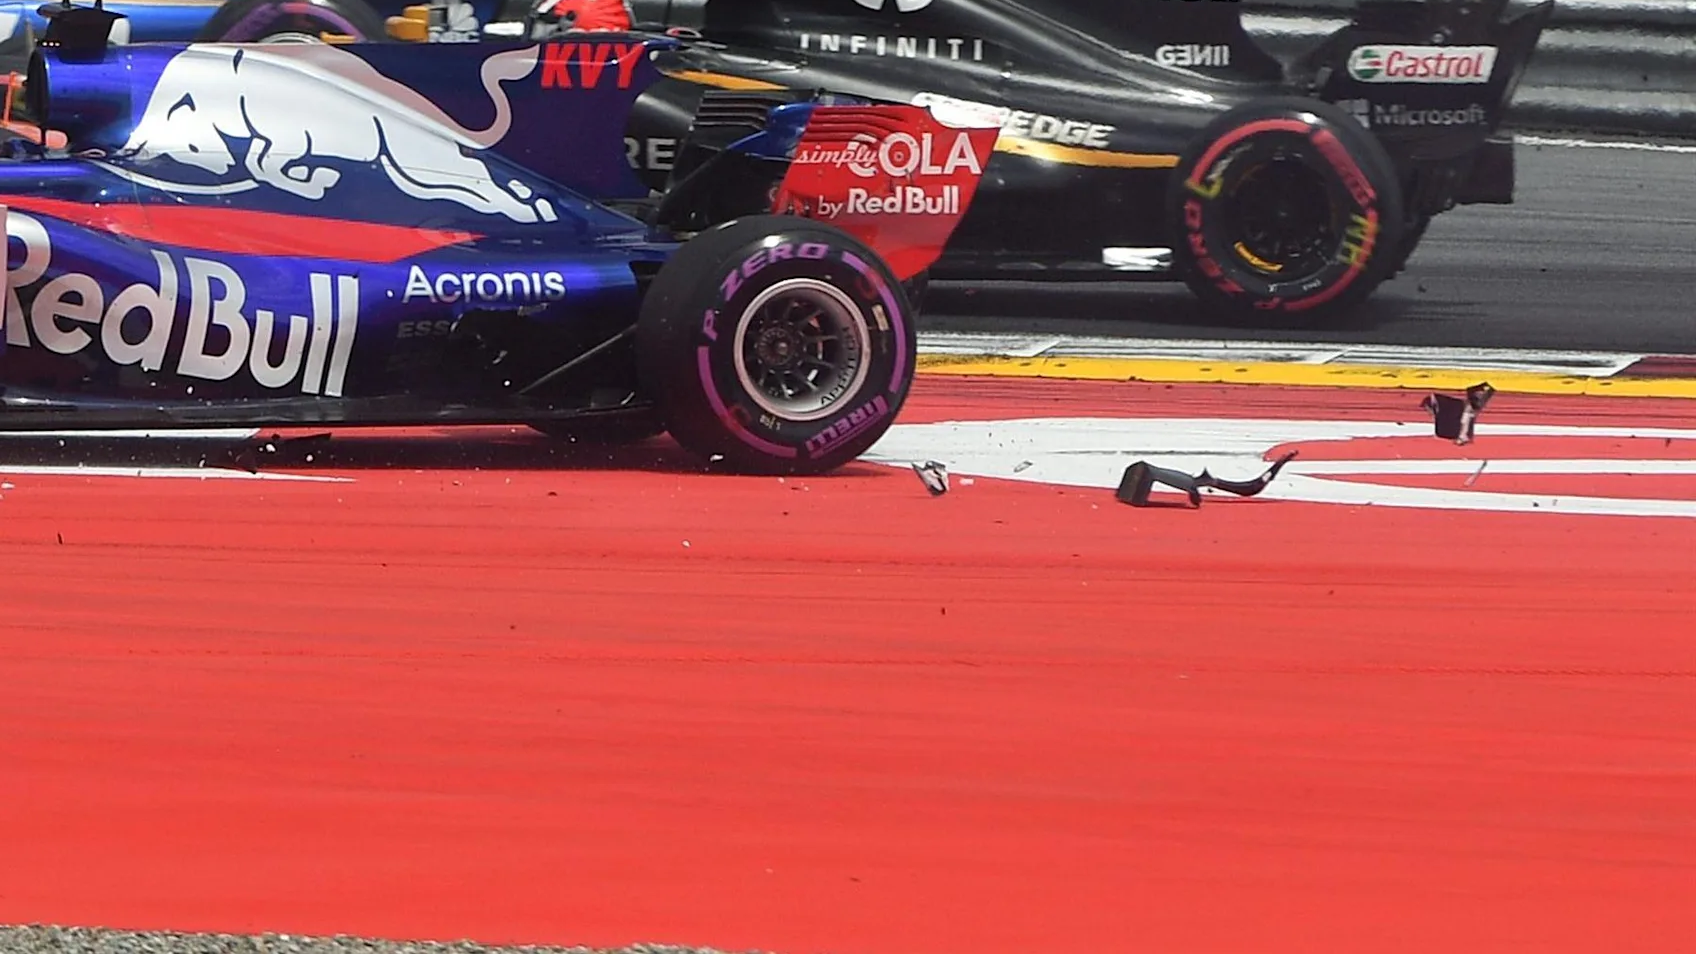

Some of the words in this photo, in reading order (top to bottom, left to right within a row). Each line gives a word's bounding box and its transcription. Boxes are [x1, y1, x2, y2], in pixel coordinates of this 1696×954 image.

[540, 42, 646, 90] KVY
[800, 33, 984, 61] INFINITI
[1385, 49, 1486, 79] Castrol
[1004, 109, 1119, 148] EDGE
[1374, 103, 1488, 126] Microsoft
[792, 144, 878, 168] simply
[847, 131, 983, 178] COLA
[817, 195, 843, 219] by
[401, 264, 567, 304] Acronis
[720, 242, 830, 302] ZERO
[805, 395, 891, 460] PIRELLI
